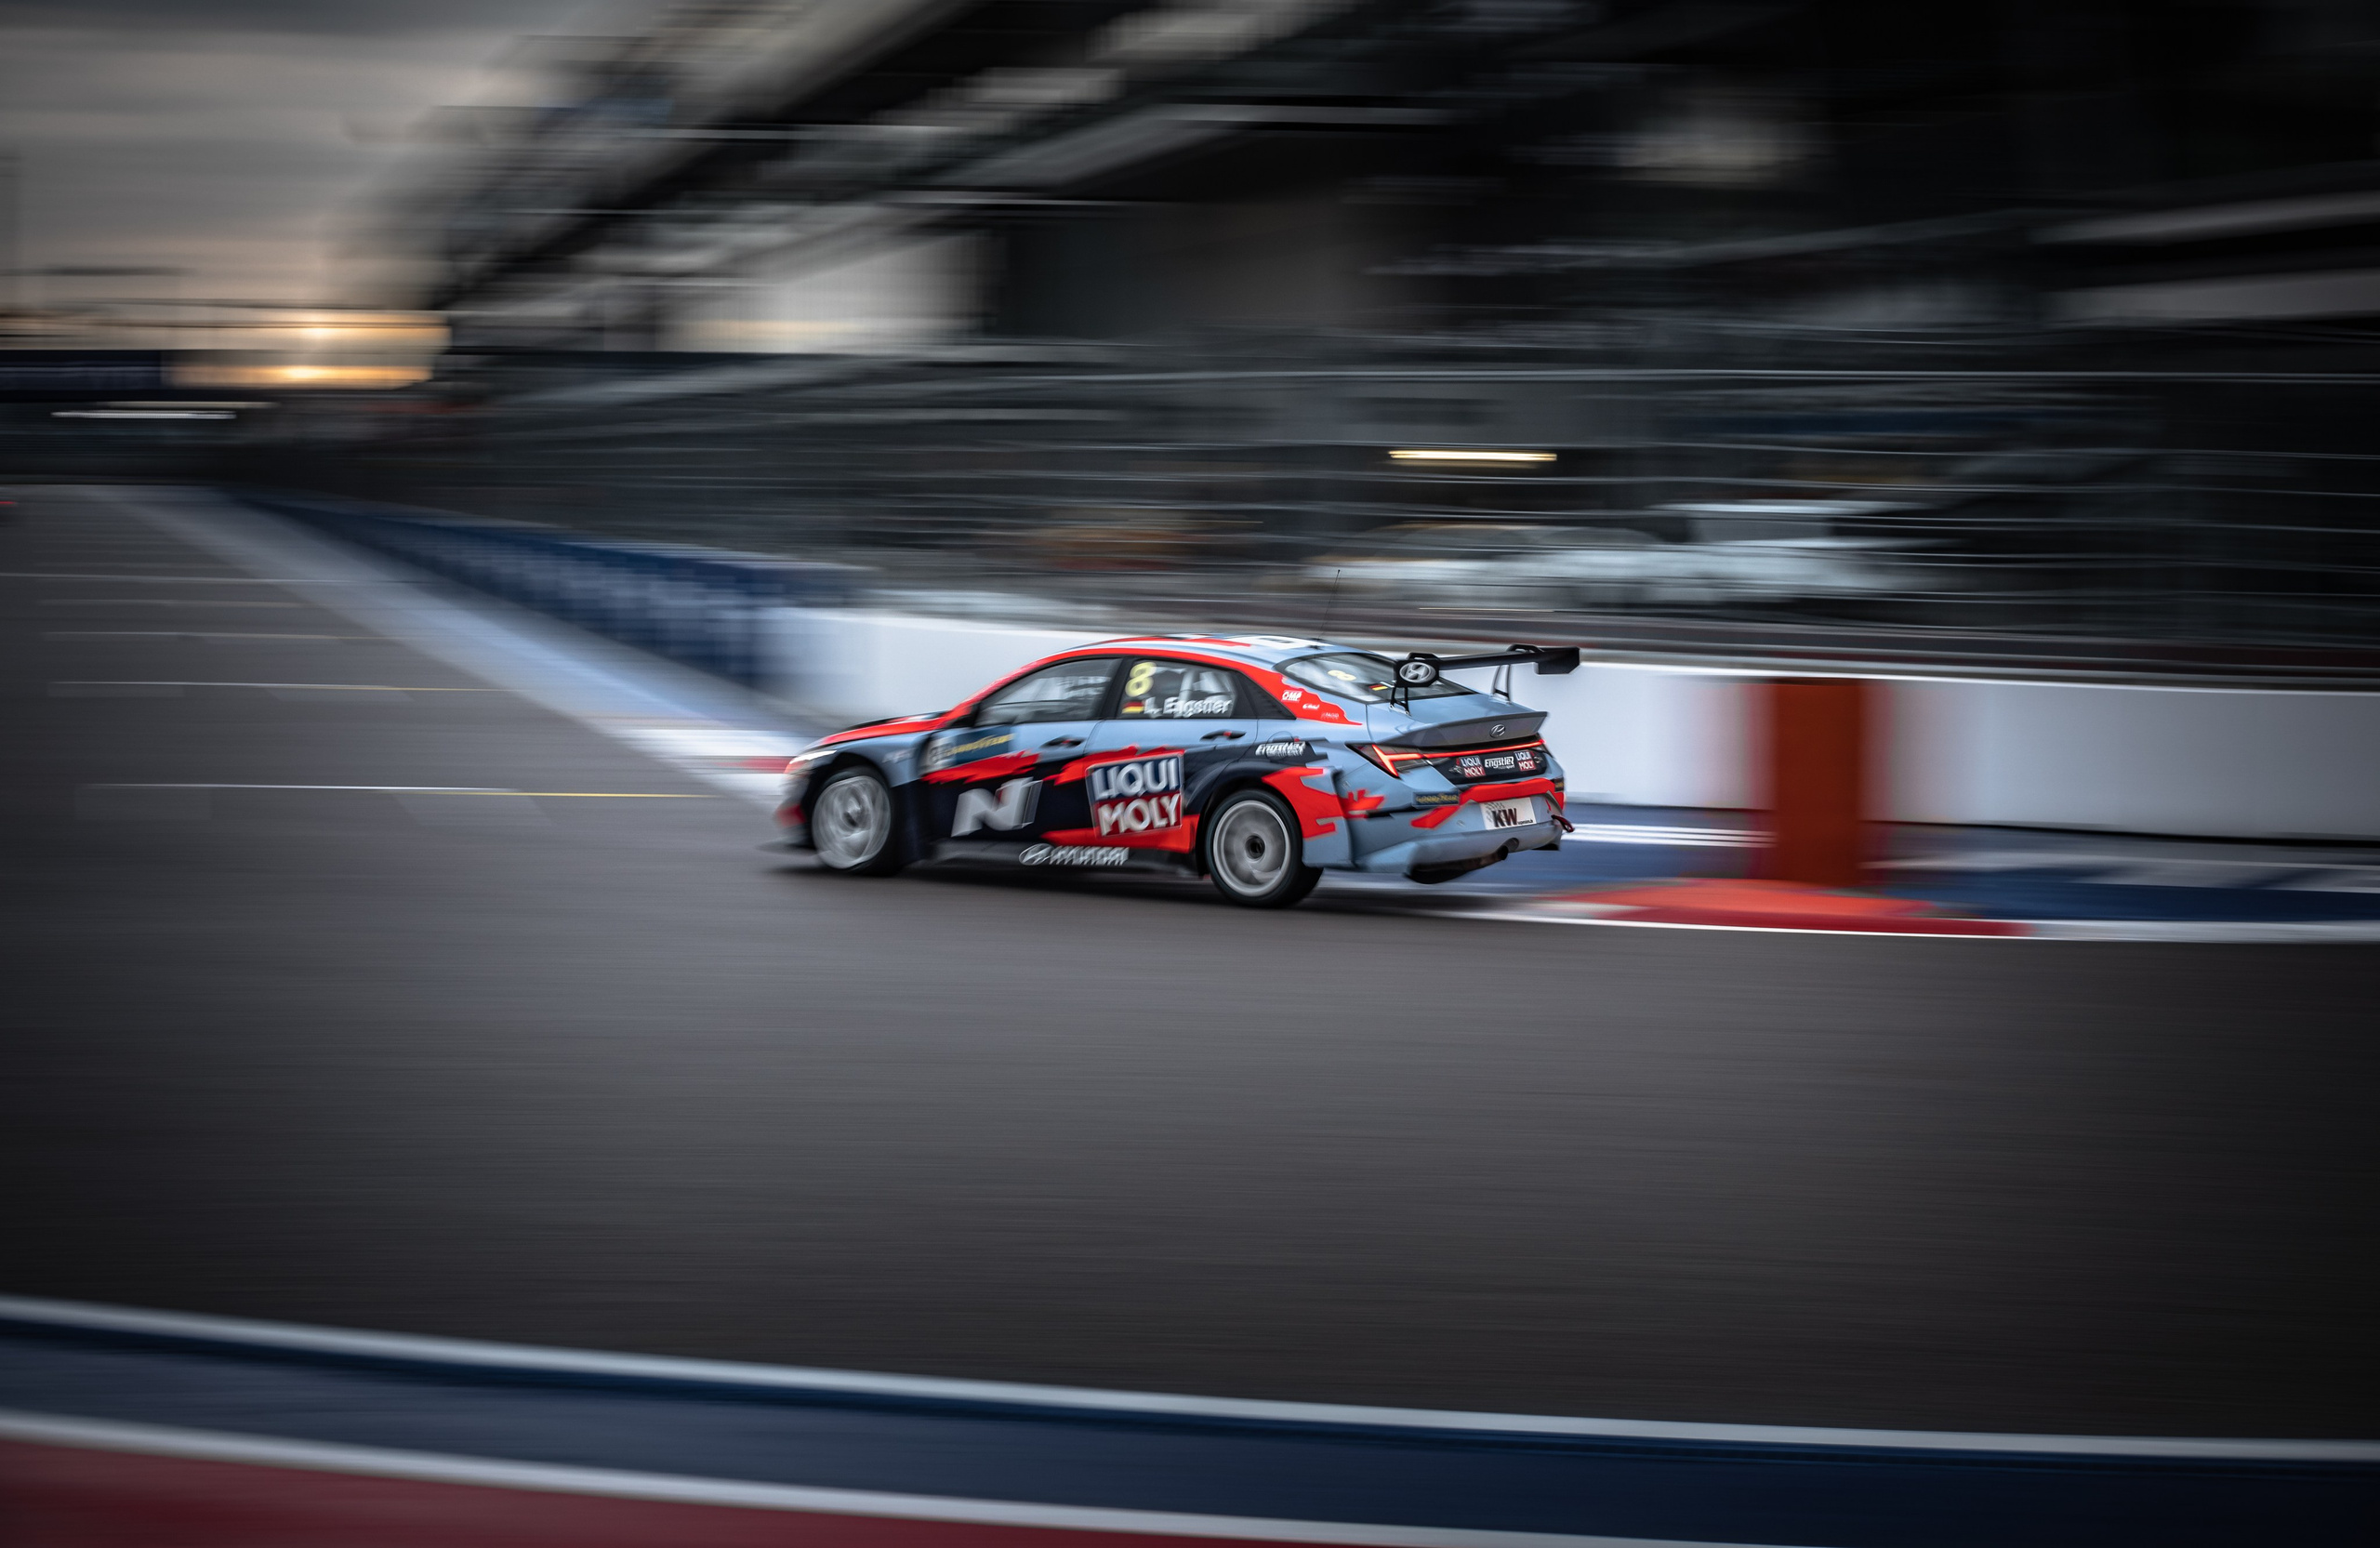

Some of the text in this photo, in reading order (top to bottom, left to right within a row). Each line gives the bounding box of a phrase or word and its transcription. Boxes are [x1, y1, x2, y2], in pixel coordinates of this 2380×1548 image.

[1125, 661, 1157, 697] 8
[1328, 669, 1356, 681] 8
[1461, 755, 1481, 767] LIQUI
[1514, 751, 1532, 761] LIQUI
[1485, 756, 1514, 769] Engstler
[1518, 760, 1536, 770] MOLY
[1463, 766, 1486, 776] MOLY
[1091, 758, 1179, 800] LIQUI
[1098, 793, 1180, 836] MOLY
[1492, 808, 1517, 827] KW
